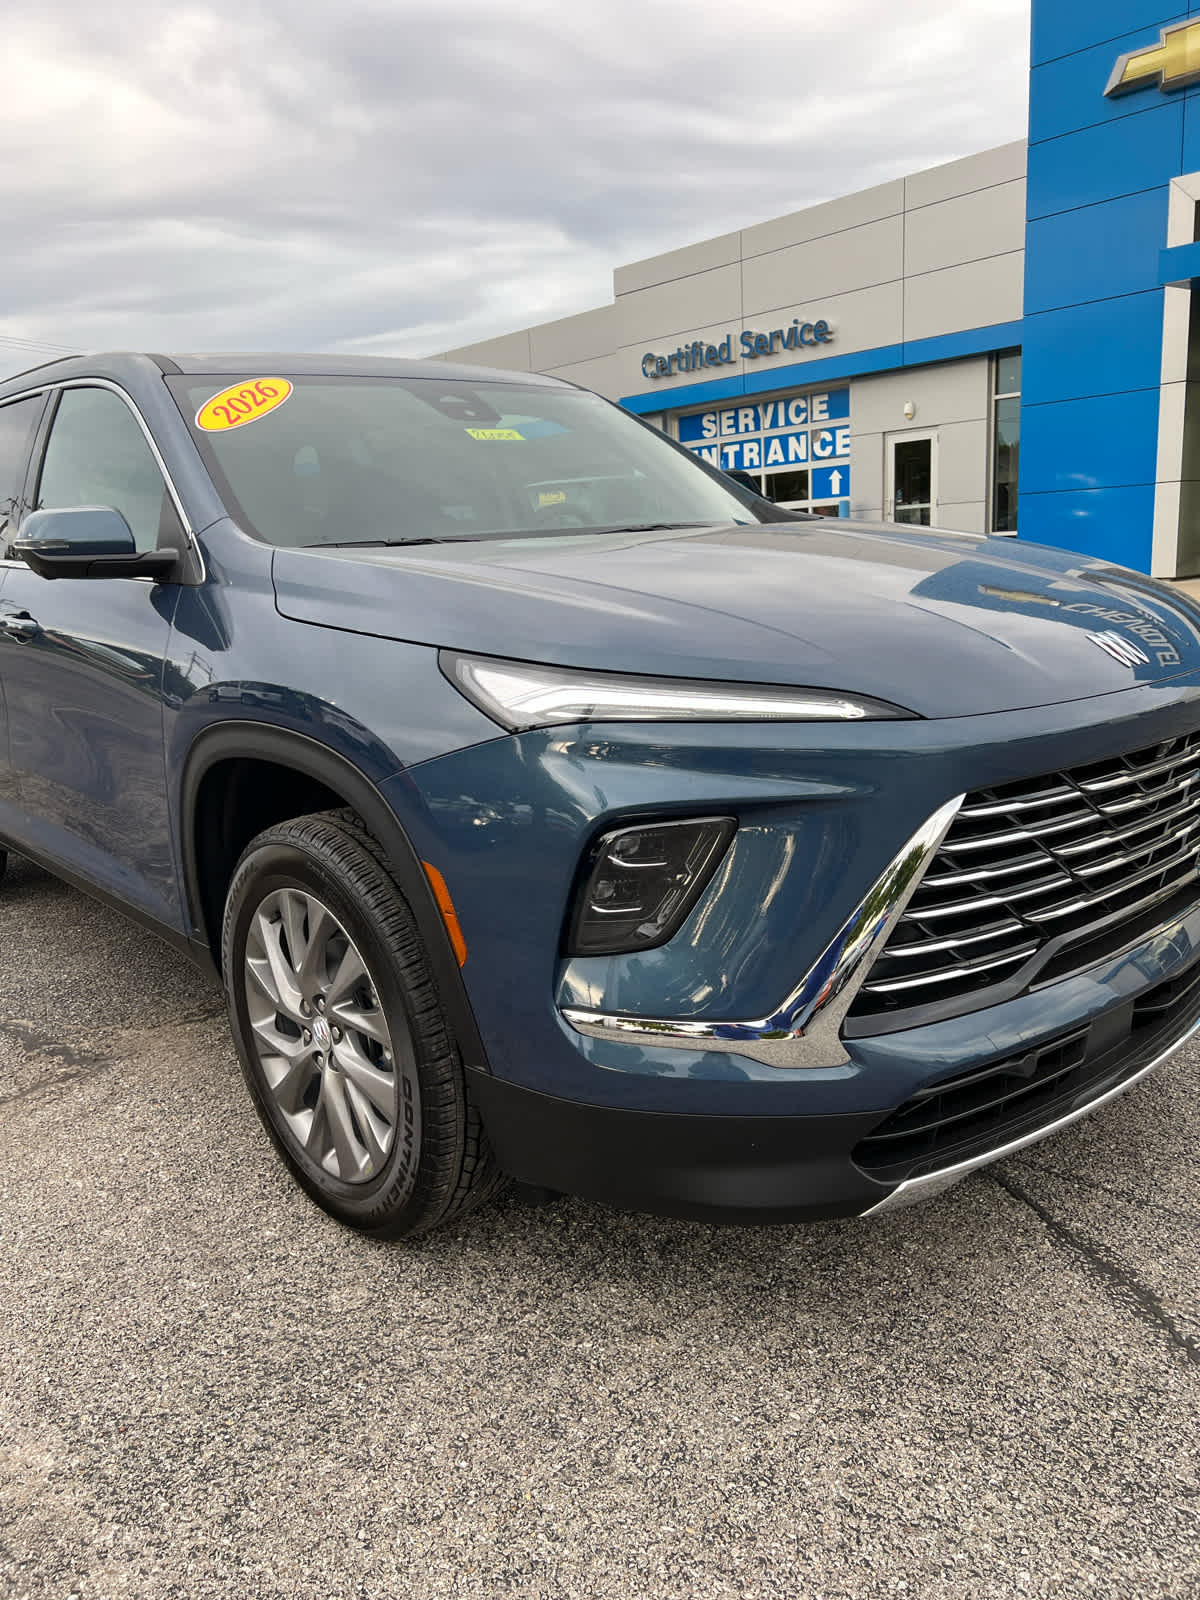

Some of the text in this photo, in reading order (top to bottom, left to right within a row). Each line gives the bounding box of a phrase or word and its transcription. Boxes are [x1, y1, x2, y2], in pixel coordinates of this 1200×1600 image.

[641, 319, 830, 378] Certified Service
[212, 381, 279, 425] 2026
[701, 393, 829, 438] SERVICE
[690, 428, 850, 469] NTRANCE
